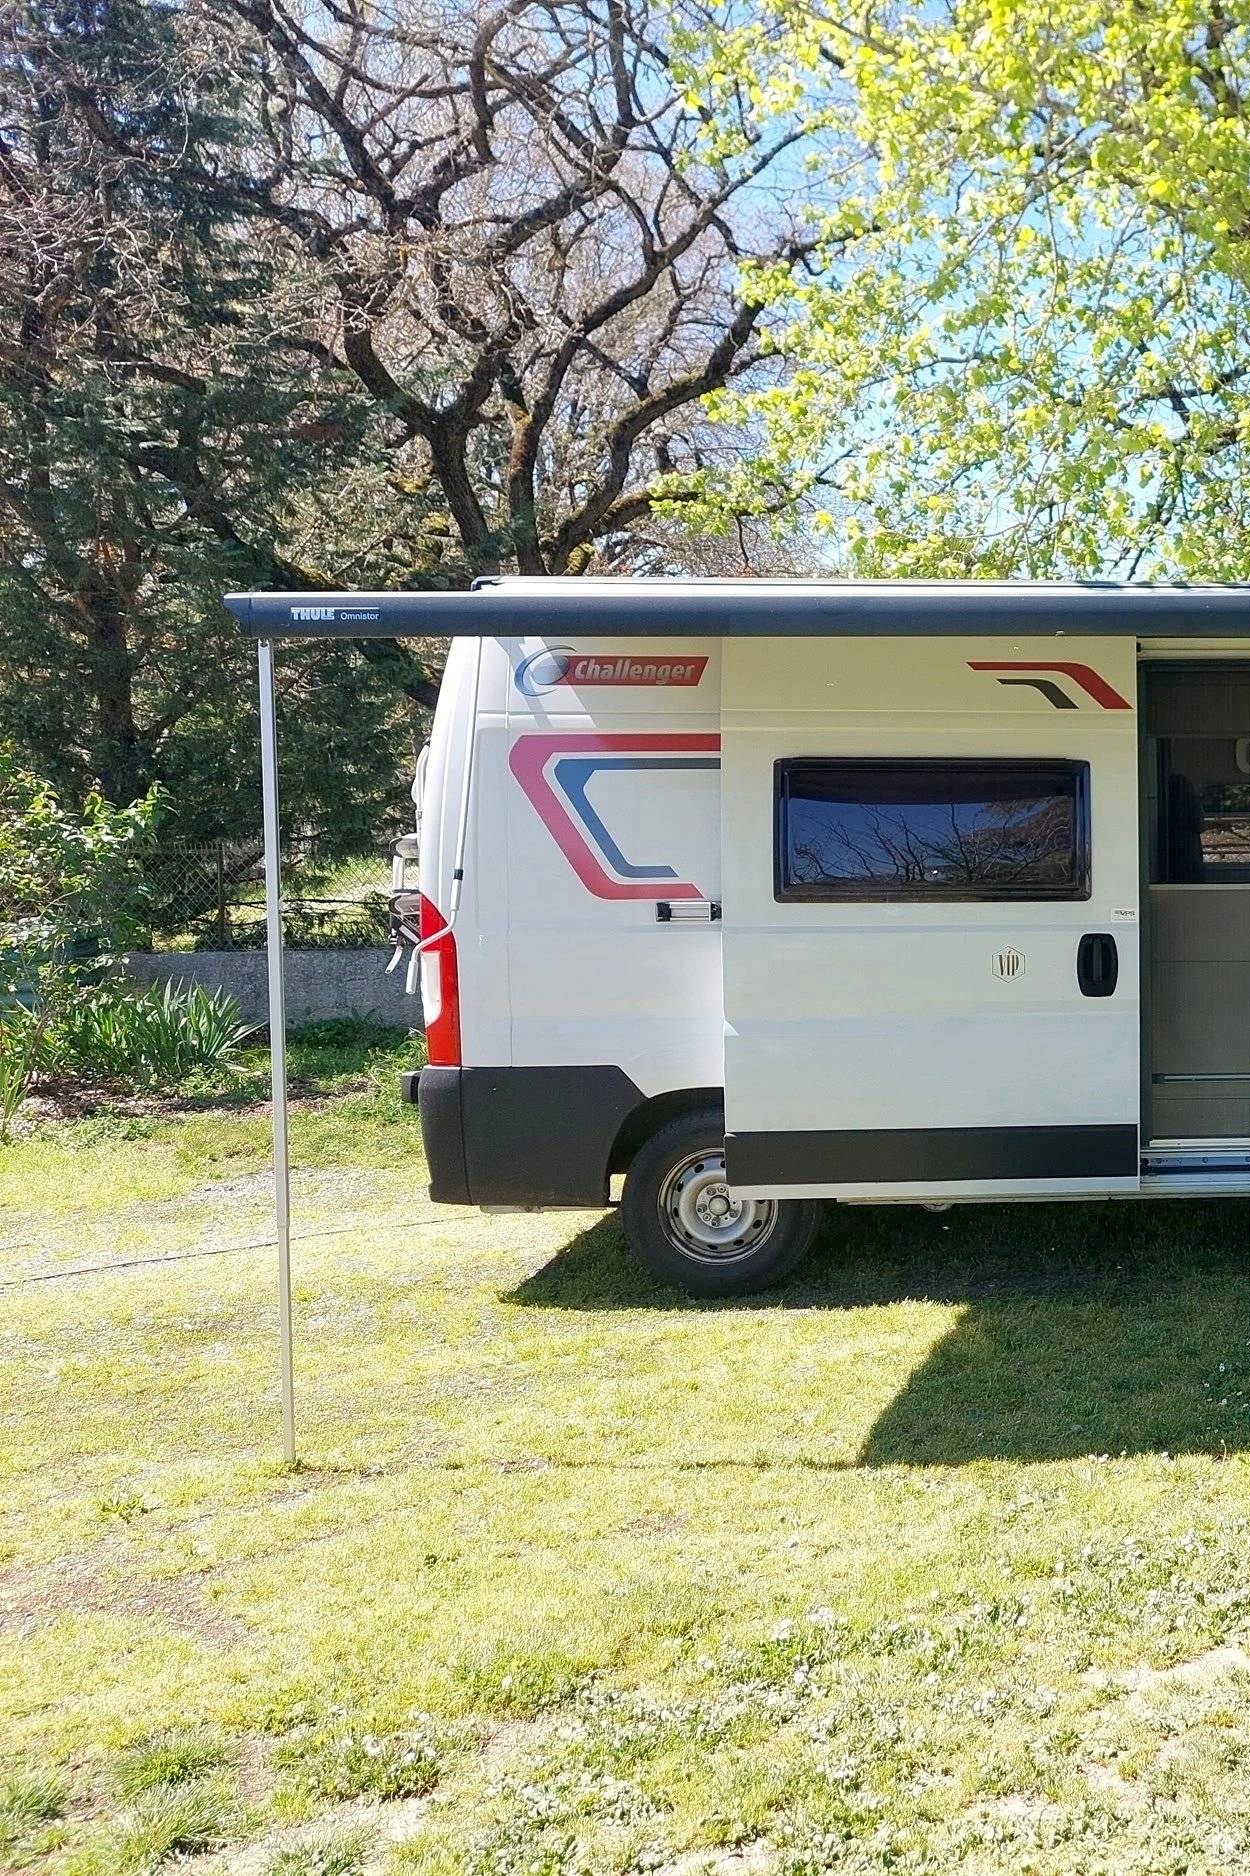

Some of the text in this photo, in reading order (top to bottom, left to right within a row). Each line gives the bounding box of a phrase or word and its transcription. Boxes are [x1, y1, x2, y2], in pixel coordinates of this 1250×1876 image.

[290, 607, 380, 620] THULE Omnistor
[575, 658, 696, 685] Challenger
